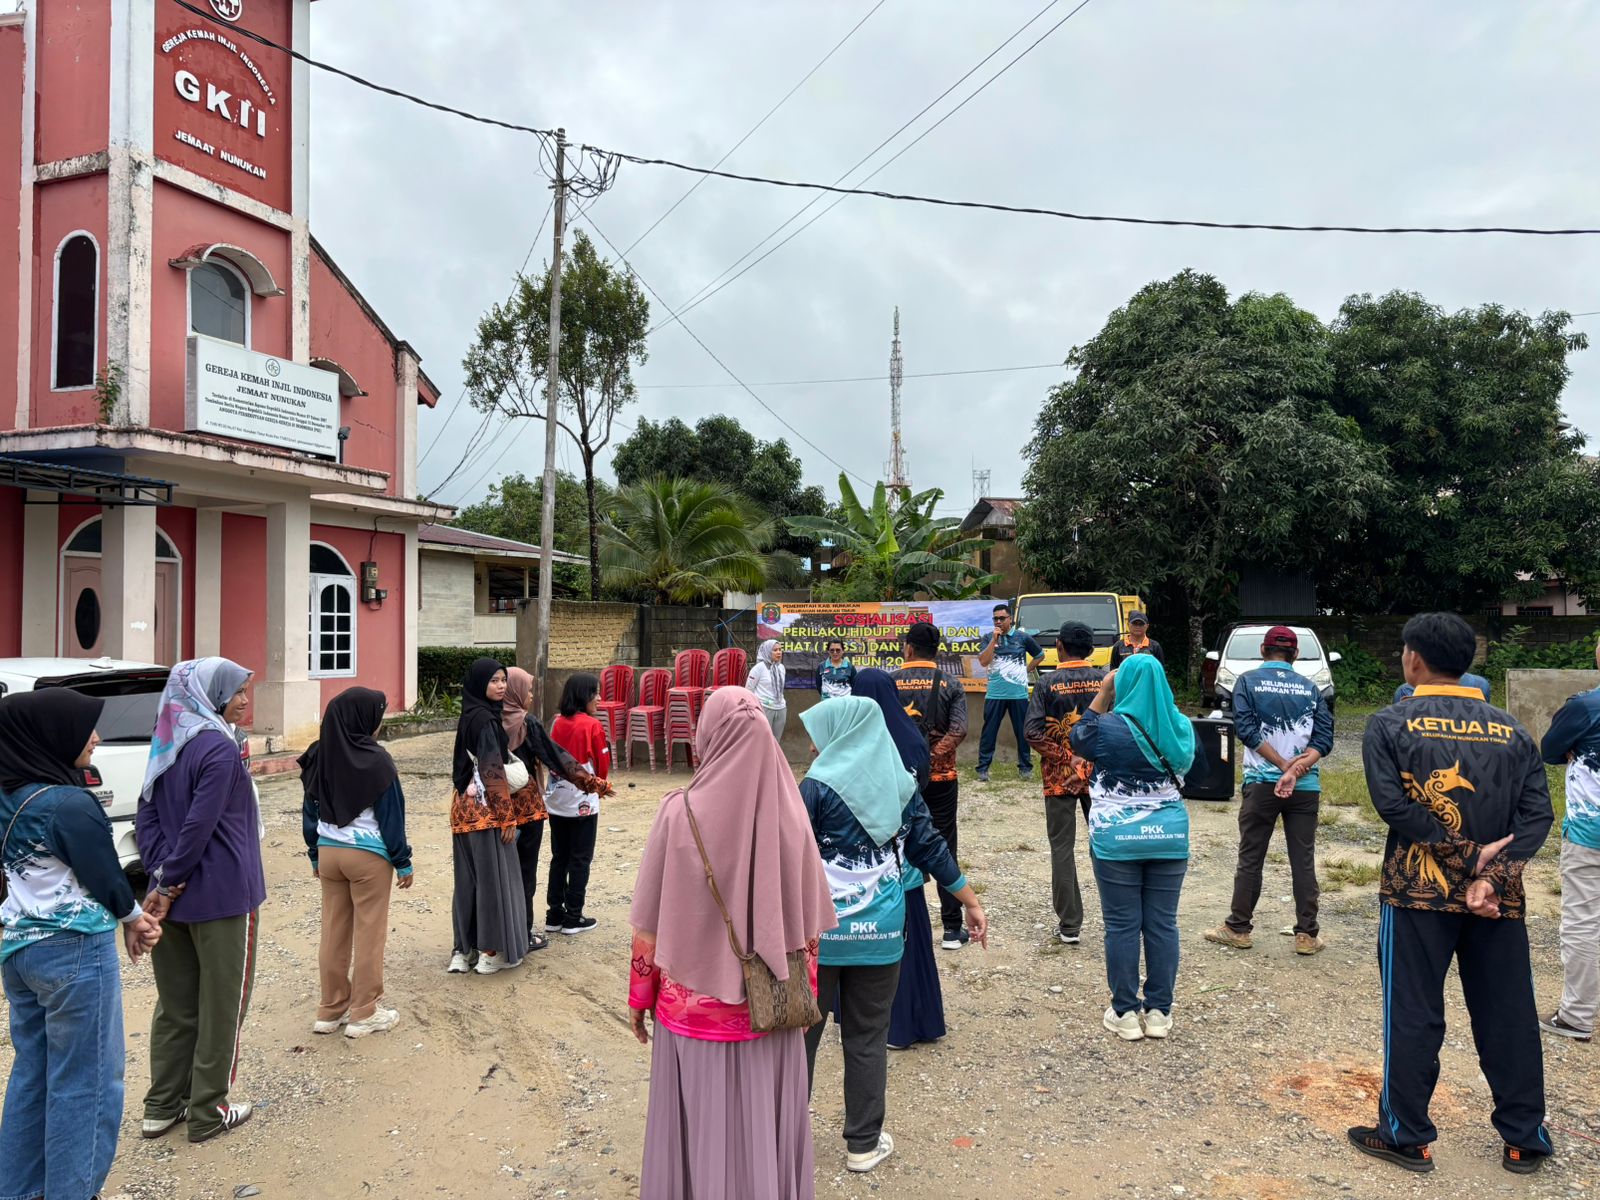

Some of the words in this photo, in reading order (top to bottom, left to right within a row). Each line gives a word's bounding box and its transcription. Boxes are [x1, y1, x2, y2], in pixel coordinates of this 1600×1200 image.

[162, 32, 188, 53] GEREJA
[187, 29, 216, 42] KEMAH
[217, 34, 238, 54] INJIL
[239, 52, 276, 105] INDONESIA
[175, 70, 266, 138] GKII
[174, 130, 215, 155] JEMAAT
[220, 150, 267, 179] NUNUKAN
[205, 363, 239, 380] GEREJA
[240, 372, 270, 387] KEMAH
[271, 380, 292, 393] INJIL
[293, 385, 333, 403] INDONESIA
[236, 385, 269, 400] JEMAAT
[270, 393, 307, 408] NUNUKAN
[833, 613, 933, 627] SOSIALISASI
[783, 627, 847, 637] PERILAKU
[850, 627, 891, 637] HIDUP
[947, 627, 979, 637] DAN
[780, 641, 812, 652] EHAT
[870, 642, 900, 652] DAN
[951, 642, 981, 653] BAK
[886, 656, 905, 667] 20
[895, 679, 948, 689] ELURAHN
[1261, 680, 1305, 690] KELURAHAN
[1254, 686, 1289, 695] NUNUKAN
[1290, 688, 1312, 696] TIMUR
[1406, 717, 1485, 735] KETUA
[1487, 722, 1514, 739] RT
[1421, 732, 1457, 740] KELURAHAN
[1140, 825, 1165, 835] PKK
[850, 921, 878, 934] PKK
[818, 932, 858, 941] KELURAHAN
[859, 933, 888, 941] NUNUKAN
